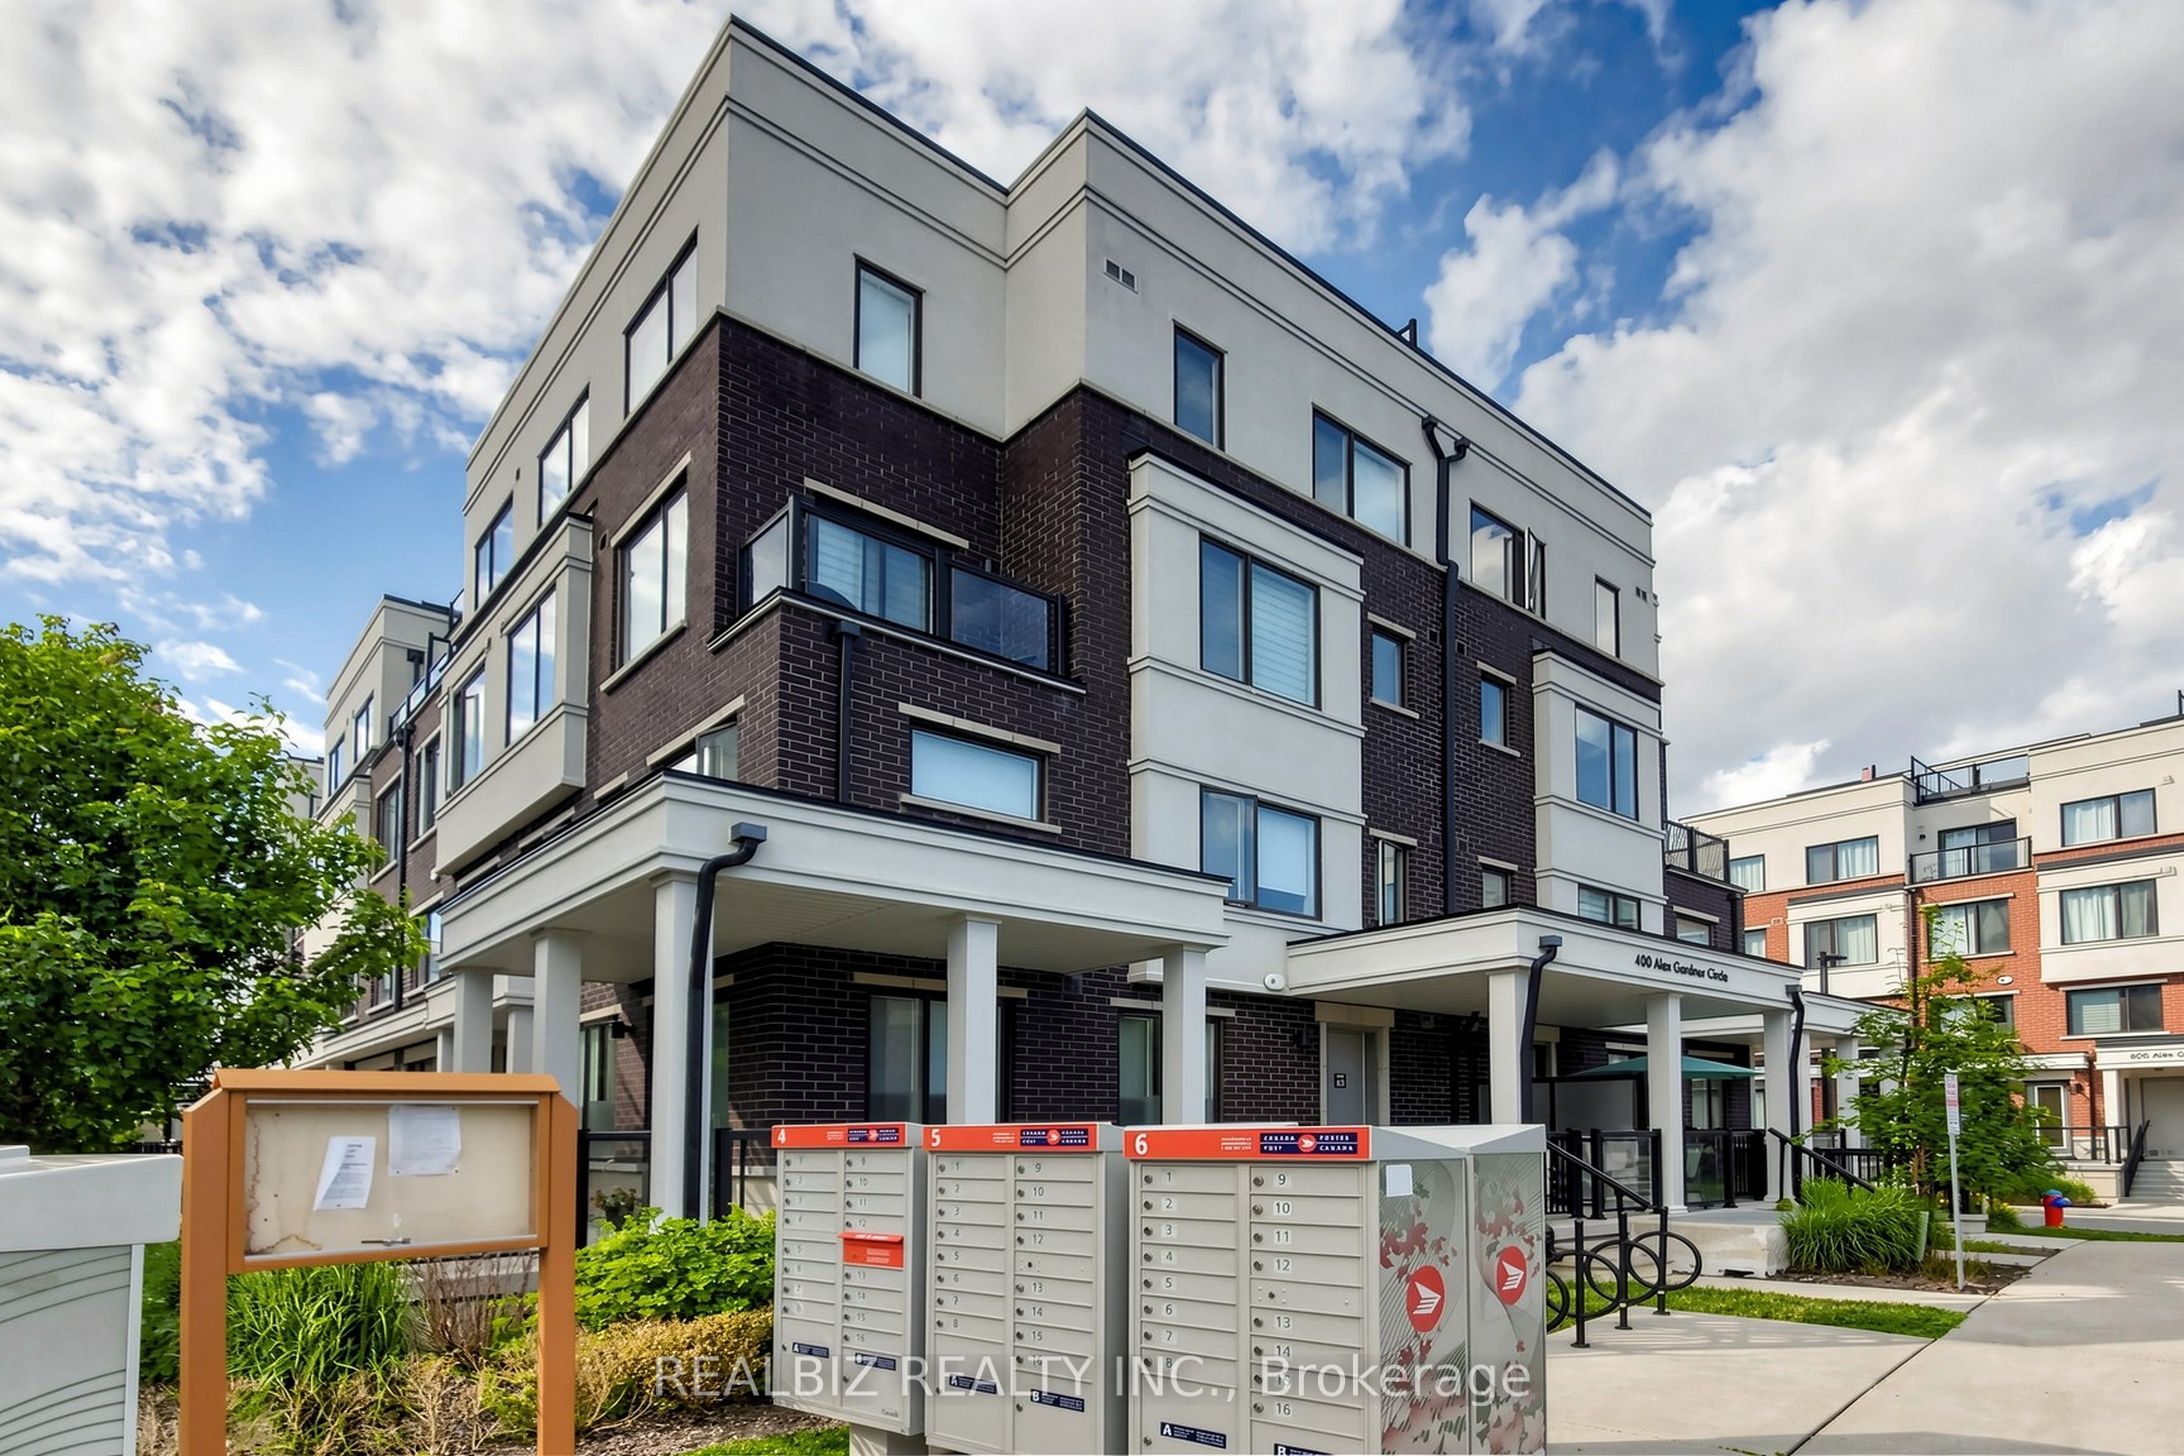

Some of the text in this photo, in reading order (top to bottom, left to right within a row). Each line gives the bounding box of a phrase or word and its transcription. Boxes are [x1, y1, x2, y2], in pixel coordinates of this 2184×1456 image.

[1635, 954, 1652, 969] 400
[1653, 958, 1671, 972] Alex
[1673, 961, 1705, 979] Gardner
[777, 1128, 786, 1144] 4
[931, 1128, 941, 1147] 5
[1134, 1133, 1148, 1155] 6
[1035, 1163, 1041, 1173] 9
[1278, 1173, 1286, 1185] 9
[1033, 1187, 1044, 1197] 10
[1166, 1198, 1172, 1209] 2
[1276, 1202, 1290, 1214] 10
[1033, 1211, 1043, 1220] 11
[954, 1229, 960, 1238] 4
[1166, 1224, 1172, 1235] 3
[1033, 1234, 1044, 1244] 12
[1276, 1231, 1289, 1242] 11
[953, 1251, 959, 1260] 5
[1166, 1251, 1173, 1261] 4
[1276, 1259, 1290, 1271] 12
[1033, 1282, 1043, 1293] 13
[1166, 1277, 1172, 1288] 5
[1032, 1307, 1043, 1317] 14
[1166, 1304, 1173, 1315] 6
[1276, 1316, 1291, 1328] 13
[1032, 1331, 1043, 1341] 15
[1166, 1330, 1173, 1341] 7
[1276, 1345, 1290, 1357] 14
[1166, 1357, 1173, 1369] 8
[1032, 1391, 1040, 1402] B
[1276, 1403, 1291, 1415] 16
[1163, 1424, 1172, 1436] A
